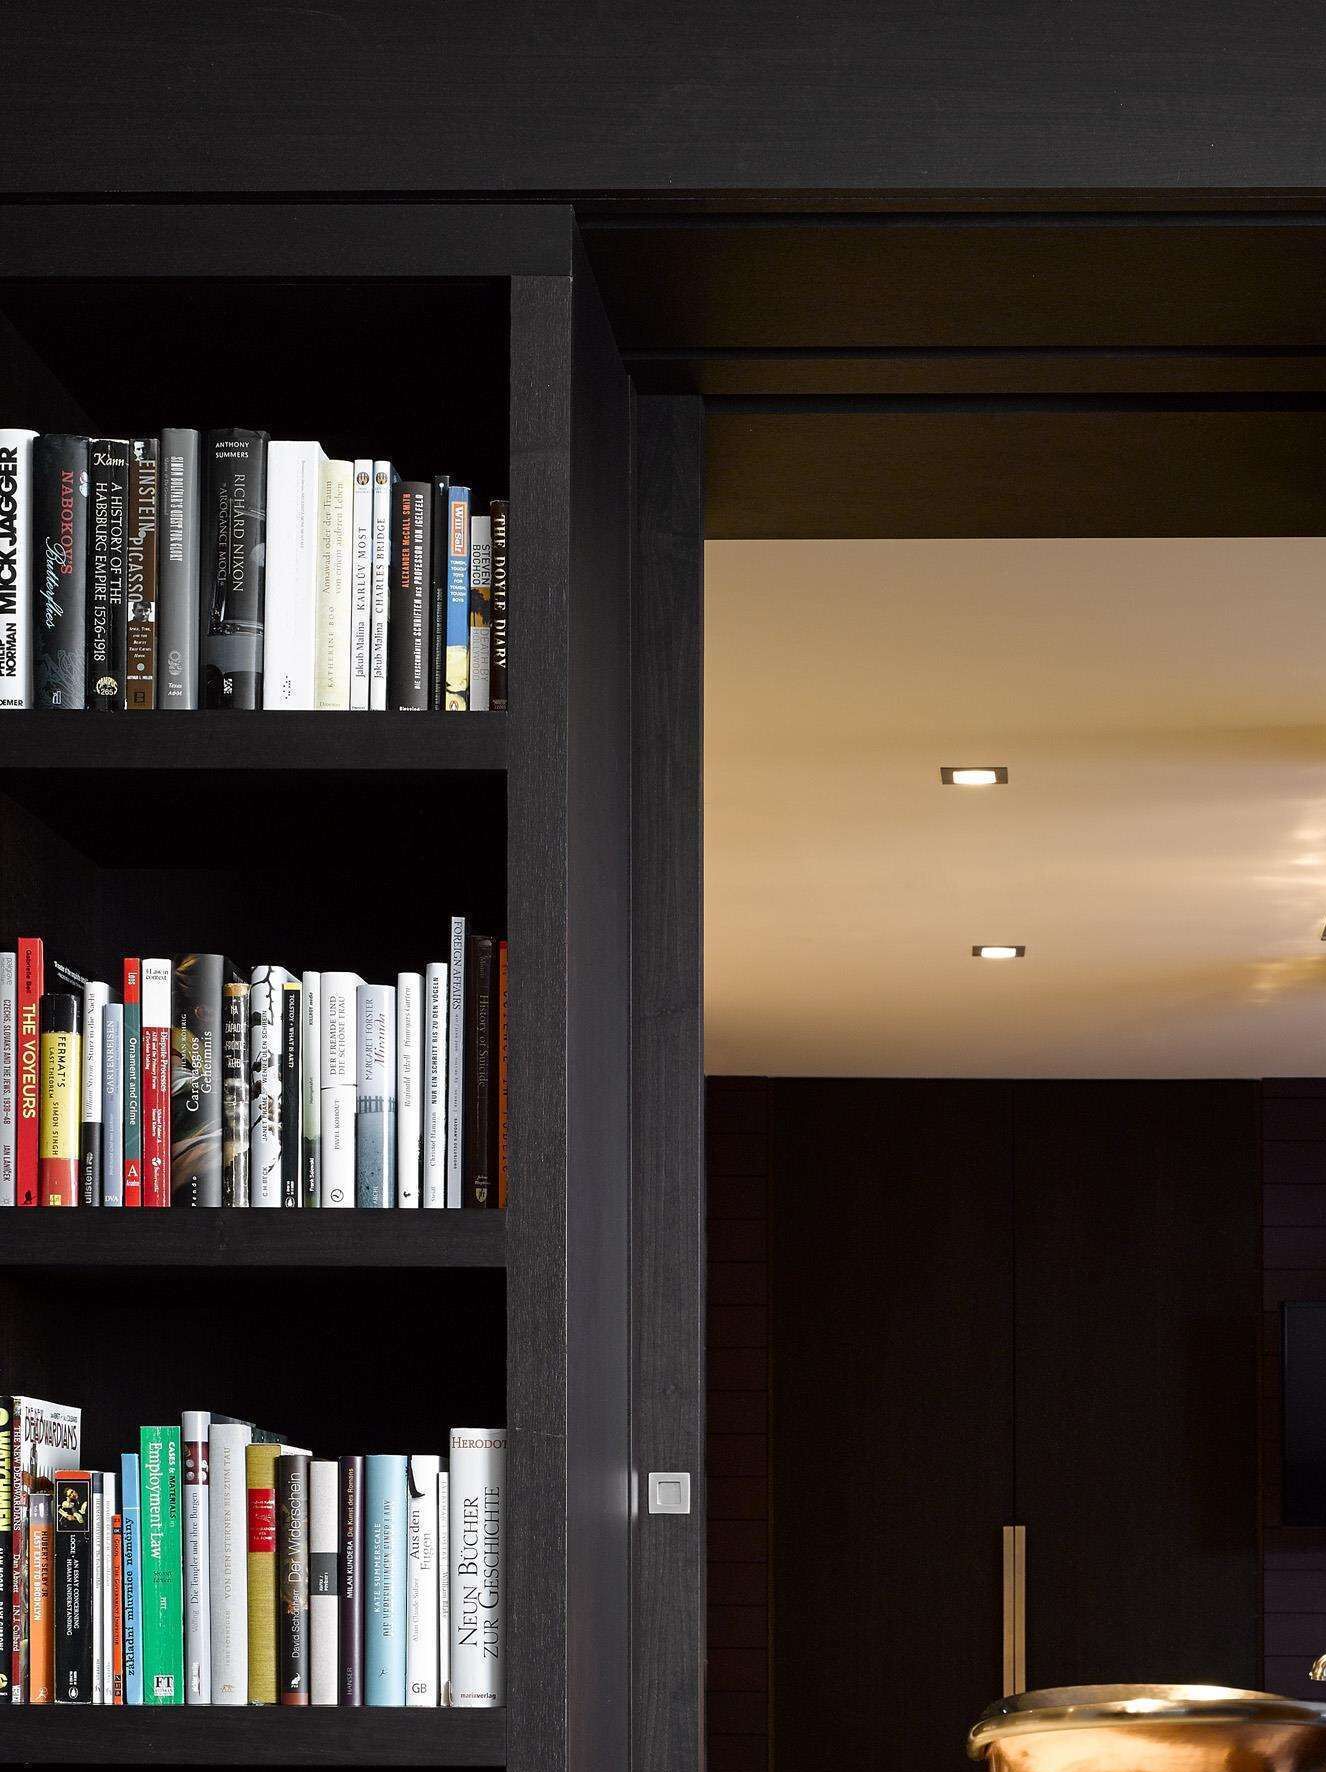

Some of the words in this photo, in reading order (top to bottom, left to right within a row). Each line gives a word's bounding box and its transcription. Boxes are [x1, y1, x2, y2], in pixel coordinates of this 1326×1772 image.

[215, 441, 250, 449] ANTHONY
[215, 451, 249, 459] SUMMERS
[0, 446, 18, 547] JAGGER
[111, 482, 122, 491] A
[138, 459, 156, 532] EINSTEIN
[233, 473, 246, 540] RICHARD
[60, 469, 74, 578] NABOKOV'S
[95, 482, 107, 551] HABSBURG
[110, 496, 122, 553] HISTORY
[494, 514, 507, 548] THE
[0, 547, 17, 615] MICK
[40, 536, 66, 630] Butterflies
[94, 555, 107, 601] EMPIRE
[110, 557, 121, 574] OF
[128, 536, 143, 602] PICASSO
[232, 544, 245, 592] NIXON
[472, 544, 481, 585] BOCHCO
[482, 544, 490, 585] STEVEN
[494, 556, 507, 611] DOYLE
[109, 576, 121, 605] THE
[5, 622, 17, 677] NORMAN
[93, 605, 106, 662] 1526-1918
[494, 619, 507, 669] DIARY
[453, 920, 462, 965] FOREIGN
[452, 967, 462, 1010] AFFAIRS
[22, 1003, 36, 1036] THE
[22, 1040, 36, 1119] VOYEURS
[57, 1036, 66, 1088] FERMAT'S
[129, 1037, 138, 1079] Ornament
[186, 1037, 203, 1112] Caravaggios
[199, 1030, 212, 1094] Geheimnis
[129, 1082, 138, 1100] and
[129, 1101, 139, 1126] Crime
[451, 1436, 507, 1449] HERODOT
[144, 1442, 163, 1531] Employment
[287, 1472, 301, 1557] Widerschein
[408, 1510, 420, 1533] den
[457, 1496, 478, 1577] BÜCHER
[123, 1517, 134, 1566] němčiny
[149, 1531, 163, 1560] Law
[409, 1535, 420, 1560] Aus
[420, 1533, 432, 1571] Fugen
[477, 1486, 500, 1610] GESCHICHTE
[287, 1558, 301, 1583] Der
[125, 1570, 135, 1621] mluvnice
[290, 1588, 301, 1633] Schönherr
[457, 1586, 478, 1648] NEUN
[125, 1626, 135, 1677] základní
[291, 1634, 301, 1659] David
[411, 1683, 427, 1694] GB
